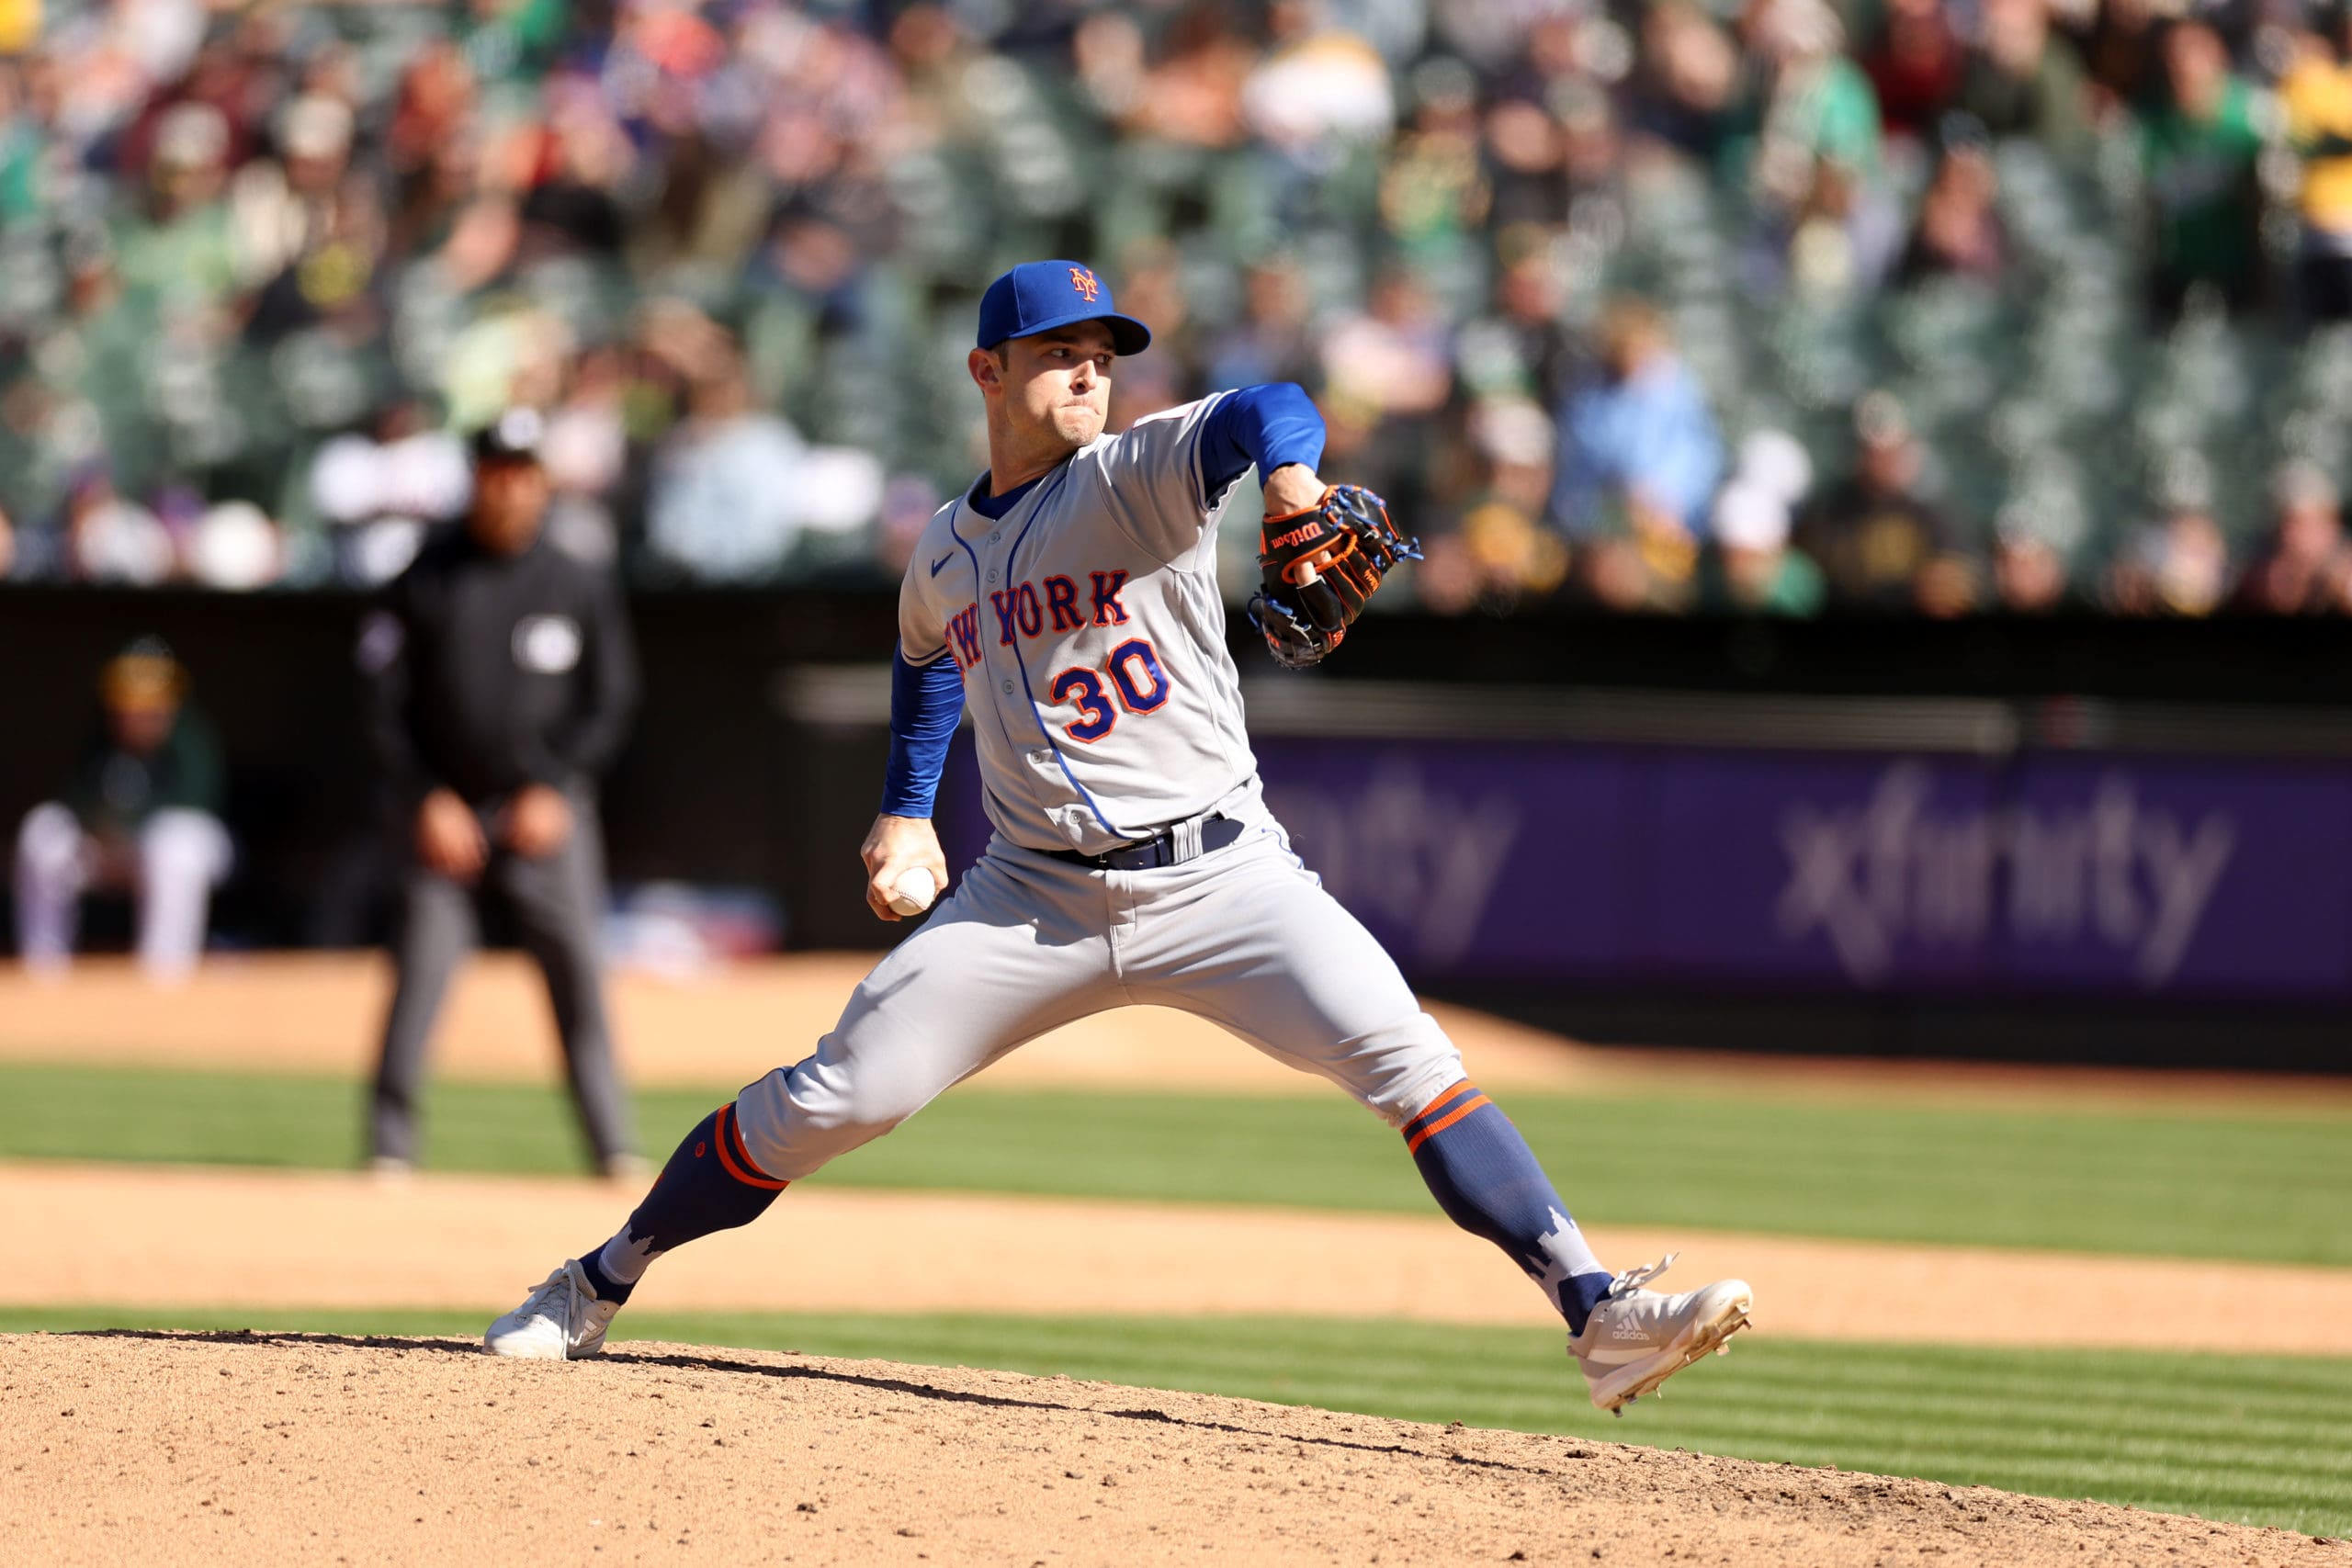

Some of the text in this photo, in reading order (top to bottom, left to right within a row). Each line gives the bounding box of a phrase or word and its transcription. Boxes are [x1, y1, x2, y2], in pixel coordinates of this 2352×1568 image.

[1271, 522, 1324, 549] Wilson
[989, 569, 1130, 647] YORK
[1050, 637, 1171, 744] 30
[1612, 1330, 1650, 1341] adidas
